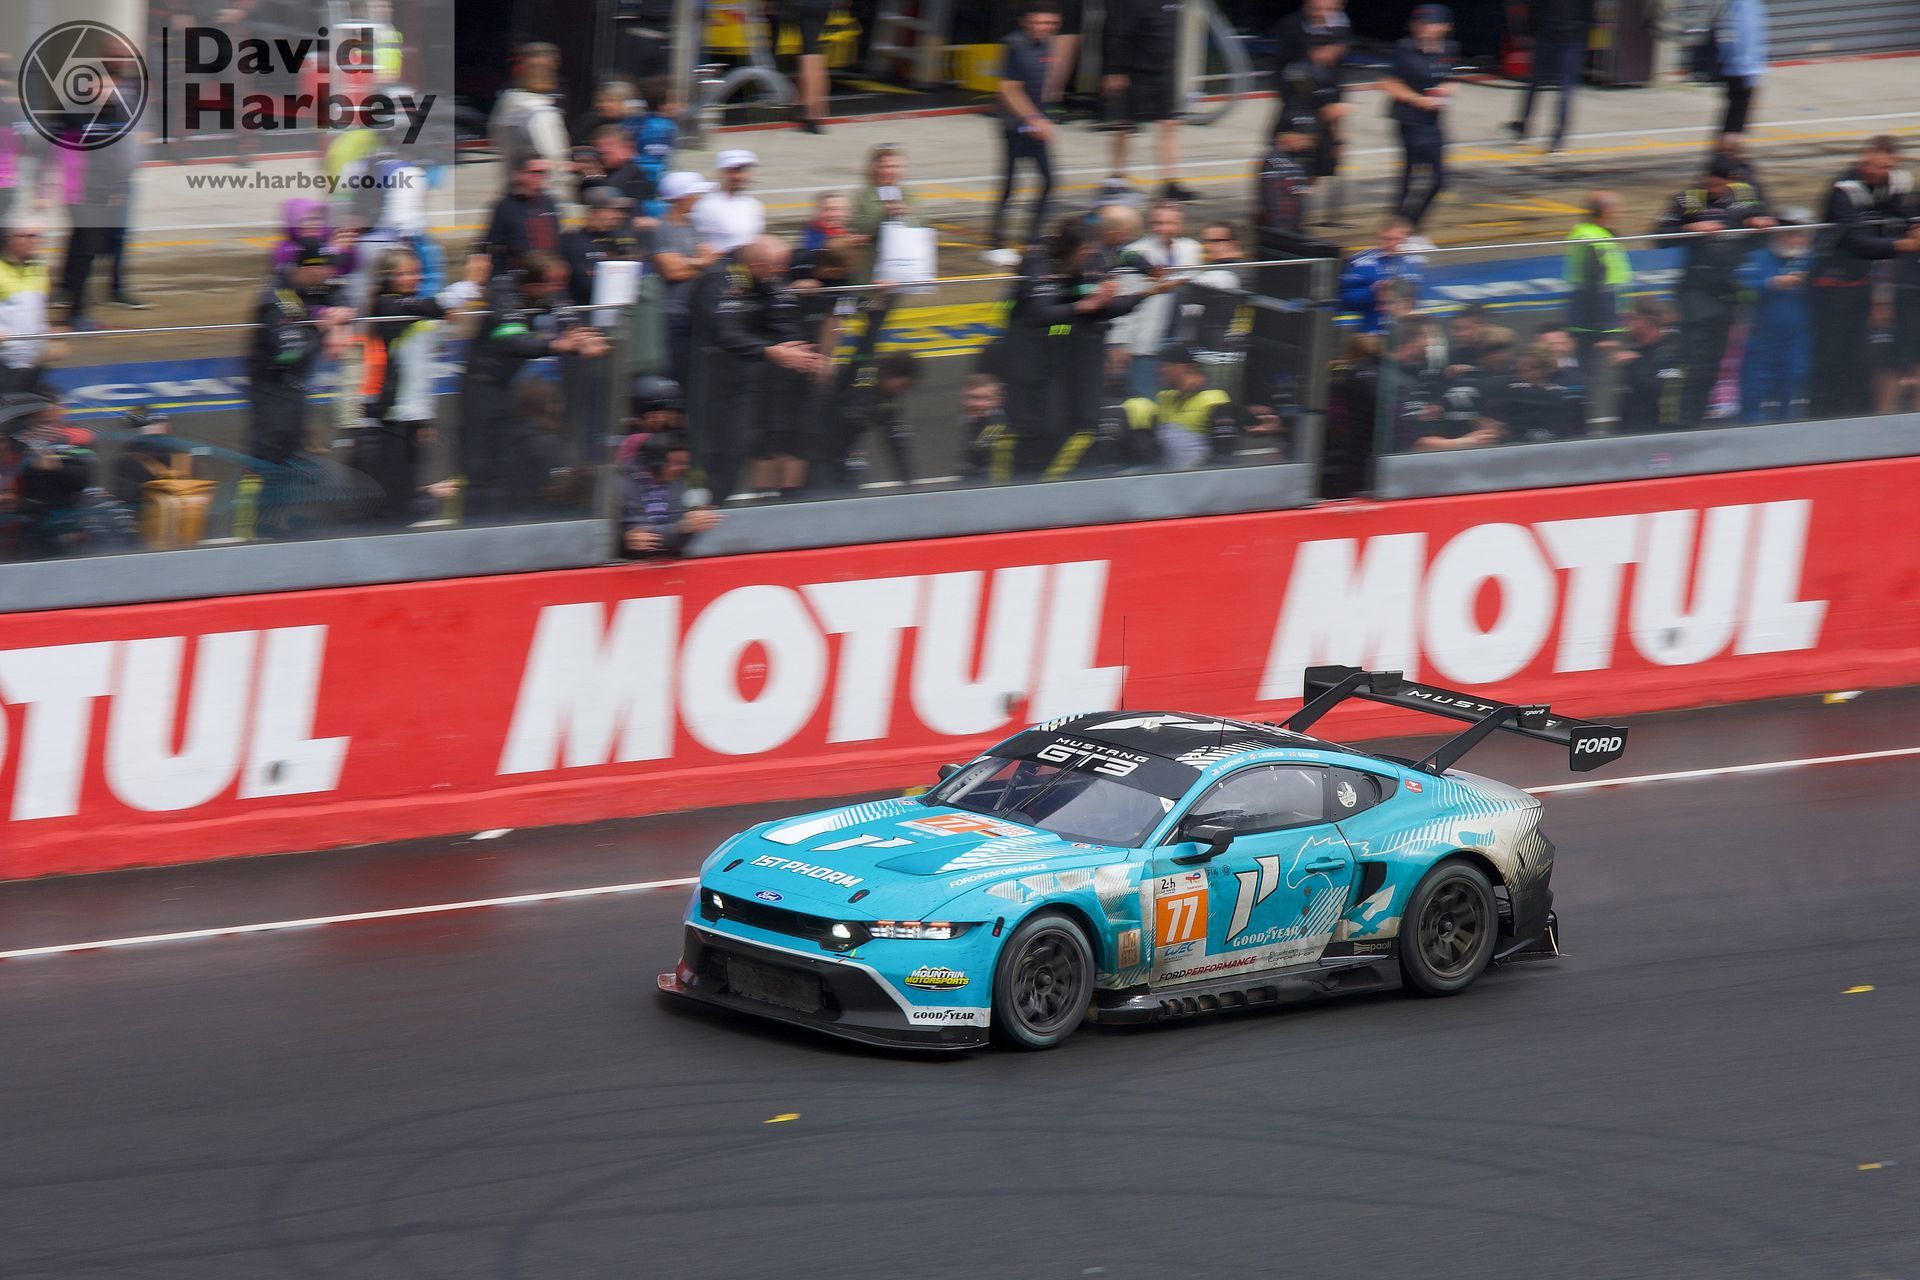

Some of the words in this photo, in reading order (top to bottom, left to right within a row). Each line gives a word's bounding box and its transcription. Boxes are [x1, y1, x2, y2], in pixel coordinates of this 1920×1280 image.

[1257, 498, 1829, 701] MOTUL
[496, 560, 1128, 776] MOTUL
[0, 624, 351, 821] TUL
[1036, 743, 1139, 777] GT3
[1055, 737, 1150, 763] MUSTANG
[1574, 736, 1622, 755] FORD
[1165, 895, 1199, 944] 77
[1370, 941, 1392, 952] paoli
[904, 976, 970, 985] MOTORSPORTS
[911, 969, 966, 978] MOUNTAIN
